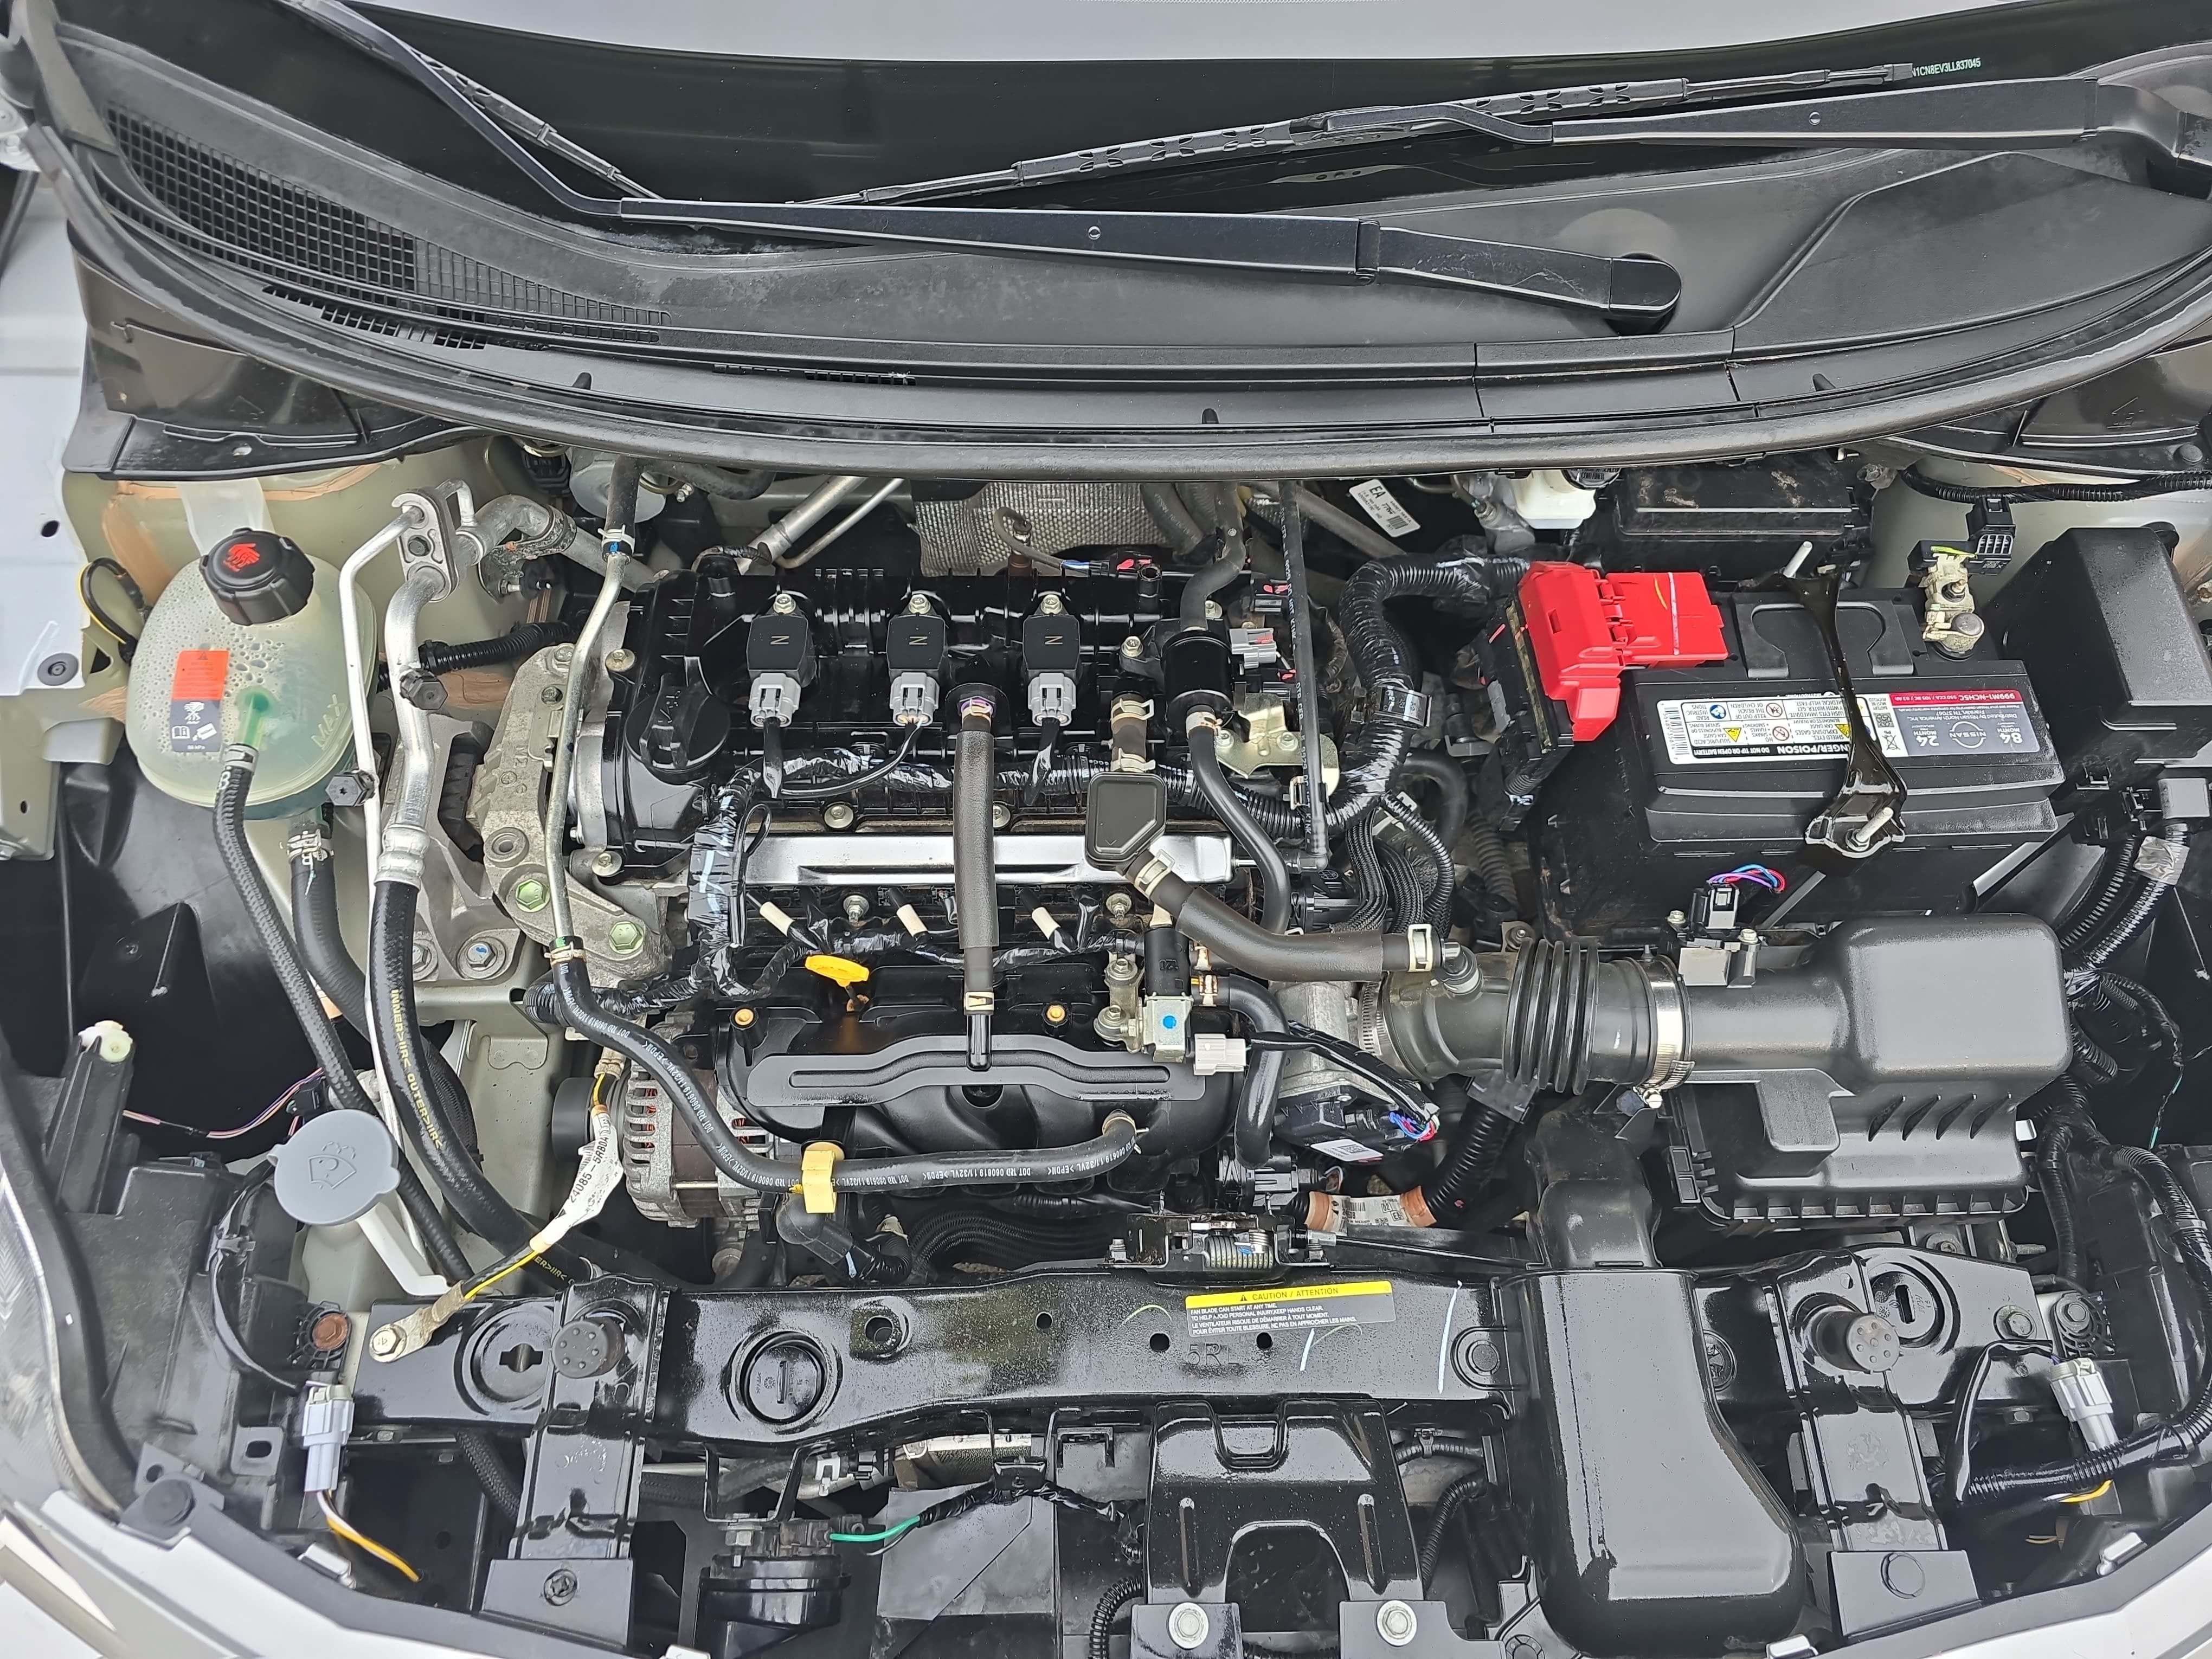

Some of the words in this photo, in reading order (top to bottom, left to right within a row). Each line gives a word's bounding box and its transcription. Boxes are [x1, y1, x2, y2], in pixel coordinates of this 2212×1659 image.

[1369, 486, 1386, 499] EA
[1916, 735, 1939, 746] 24
[1999, 732, 2023, 743] 84
[1777, 744, 1849, 754] NGER/POISON
[560, 962, 569, 974] DOT
[617, 1028, 631, 1038] DOT
[684, 1086, 700, 1110] 060619
[702, 1120, 714, 1134] DOT
[1105, 1146, 1126, 1162] 060619
[1076, 1156, 1104, 1169] 11/32VL
[950, 1169, 978, 1179] 11/32VL
[1019, 1167, 1031, 1176] DOT
[751, 1173, 773, 1186] 060619
[841, 1178, 865, 1186] 11/32VL
[866, 1176, 886, 1186] 060619
[898, 1174, 909, 1183] DOT
[1383, 1203, 1391, 1212] 02
[1253, 1292, 1287, 1300] CAUTION
[1296, 1288, 1339, 1297] ATTENTION
[1243, 1323, 1271, 1332] BLESSURE,
[1297, 1317, 1329, 1326] APPROCHER
[1261, 1315, 1287, 1323] DÉMARRER
